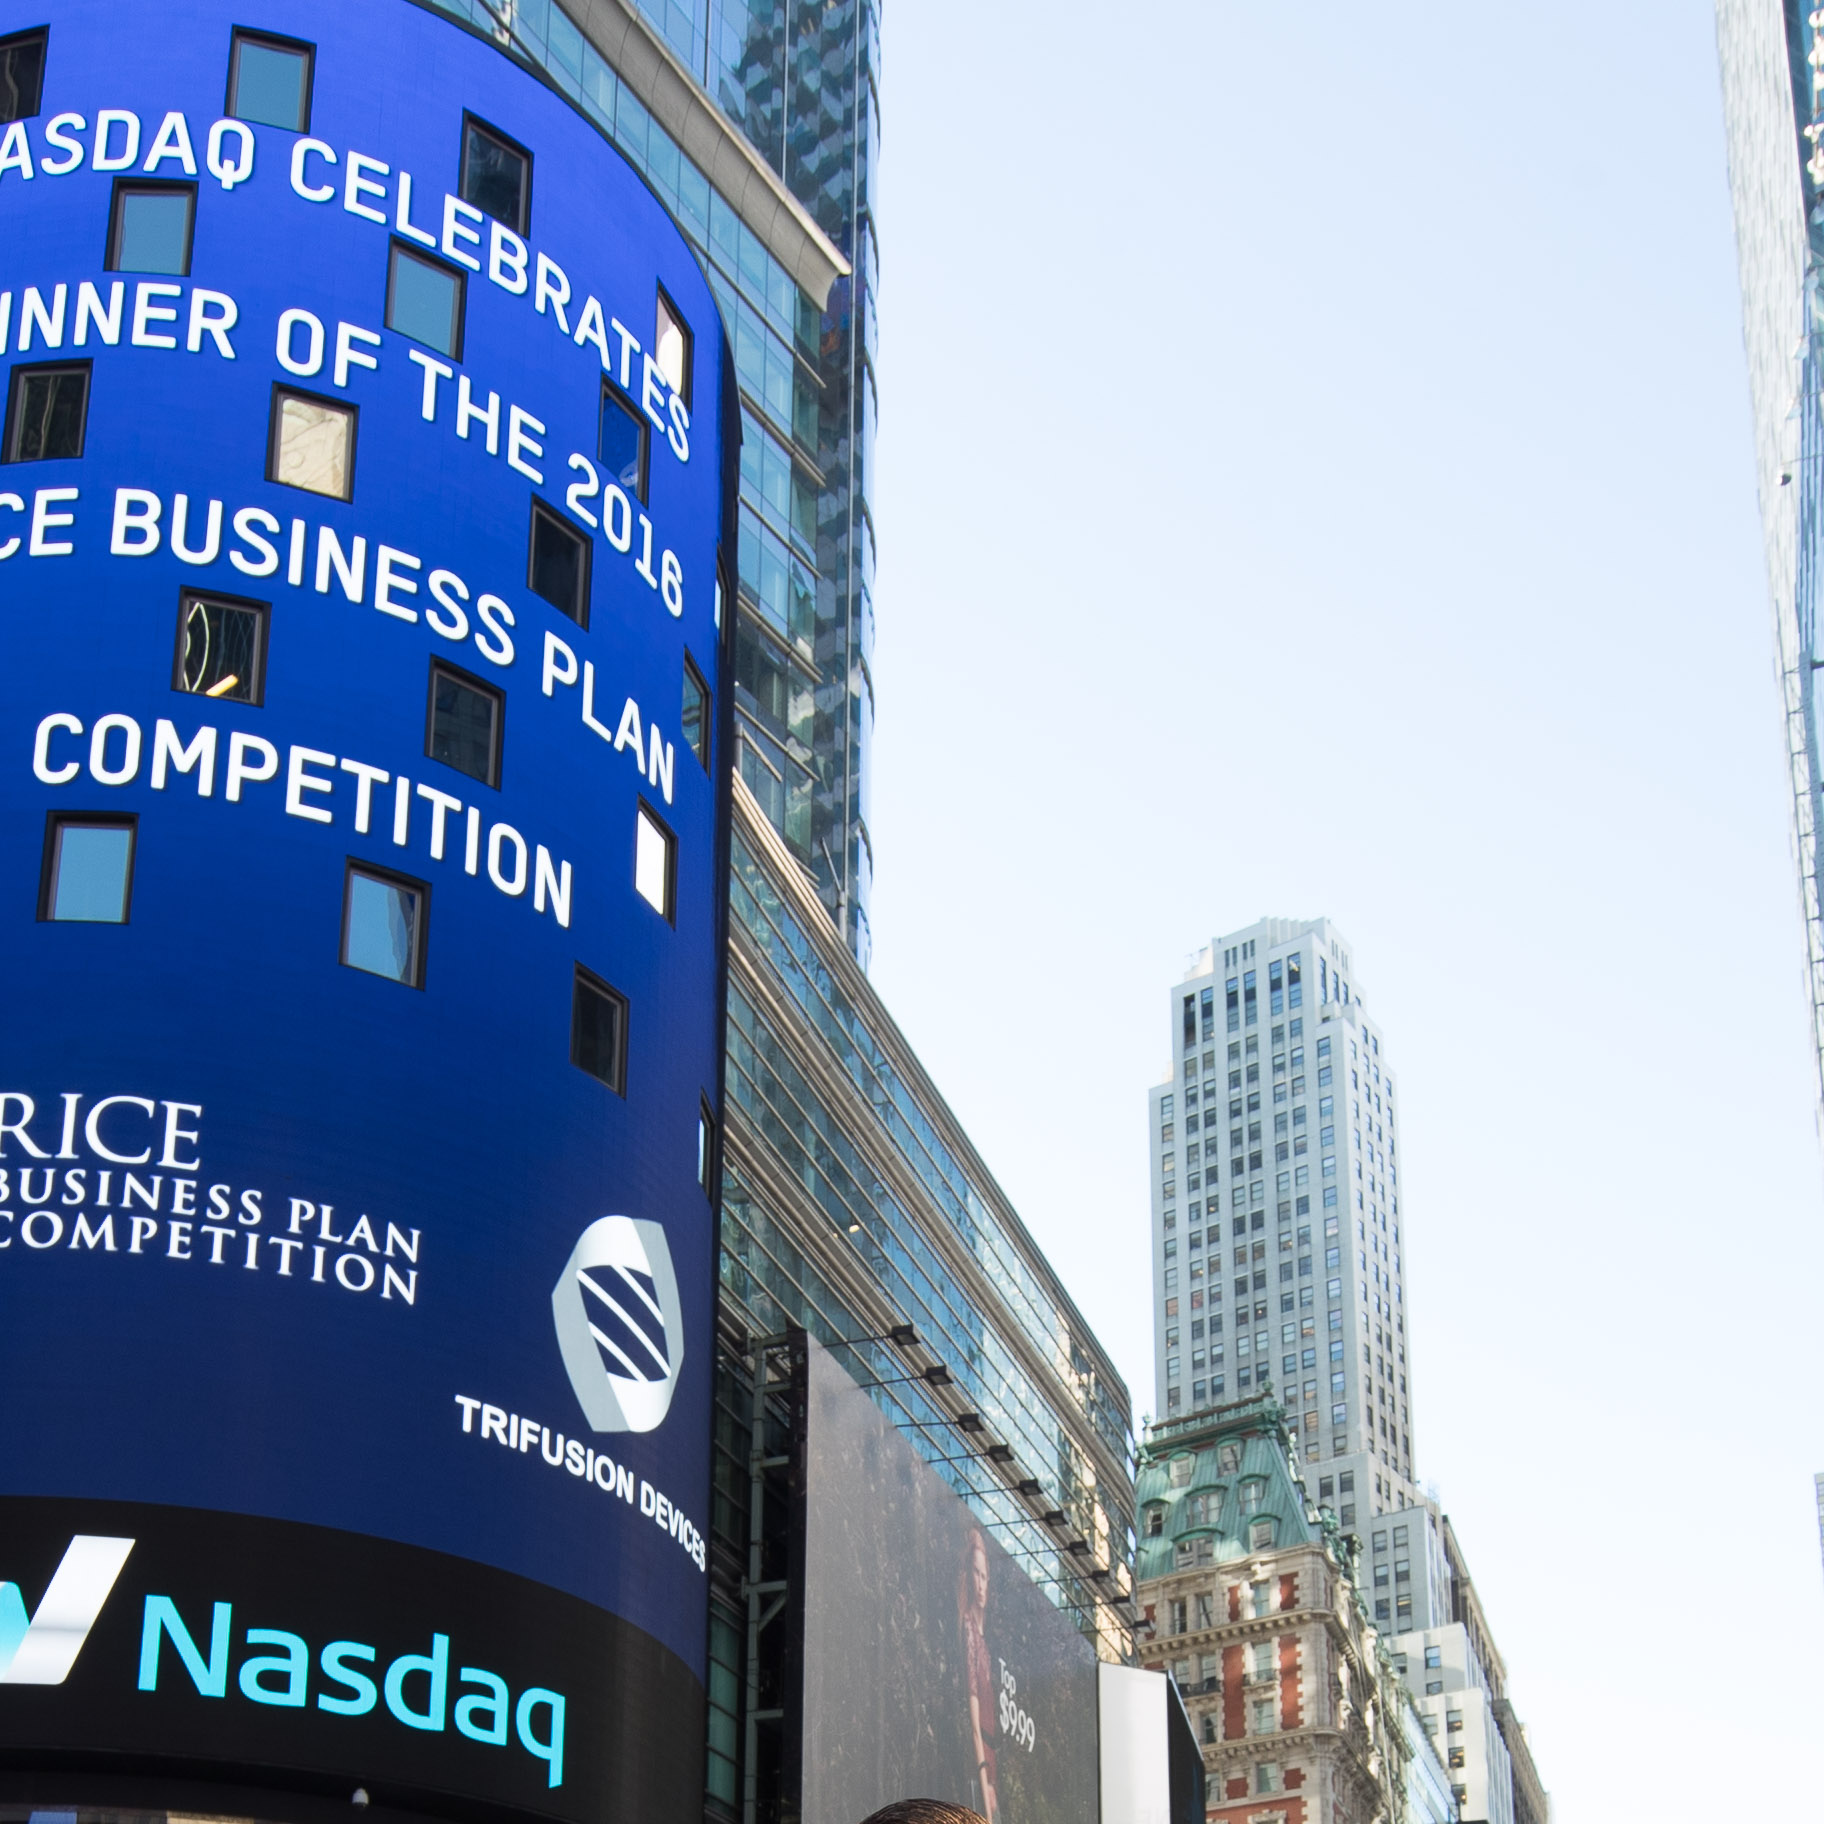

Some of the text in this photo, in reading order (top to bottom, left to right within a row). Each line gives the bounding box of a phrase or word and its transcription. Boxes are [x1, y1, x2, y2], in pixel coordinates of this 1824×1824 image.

[290, 136, 692, 464] CELEBRATES
[276, 308, 381, 388] OF
[408, 349, 546, 485] THE
[566, 452, 684, 618] 2016
[109, 485, 515, 667] BUSINESS
[541, 630, 674, 804] PLAN
[33, 712, 573, 929] COMPETITION
[288, 1197, 422, 1265] PLAN
[454, 1394, 707, 1574] TRIFUSION DEVICES
[137, 1593, 566, 1789] Nasdaq
[998, 1657, 1016, 1699] Top
[999, 1689, 1036, 1753] $9.99
